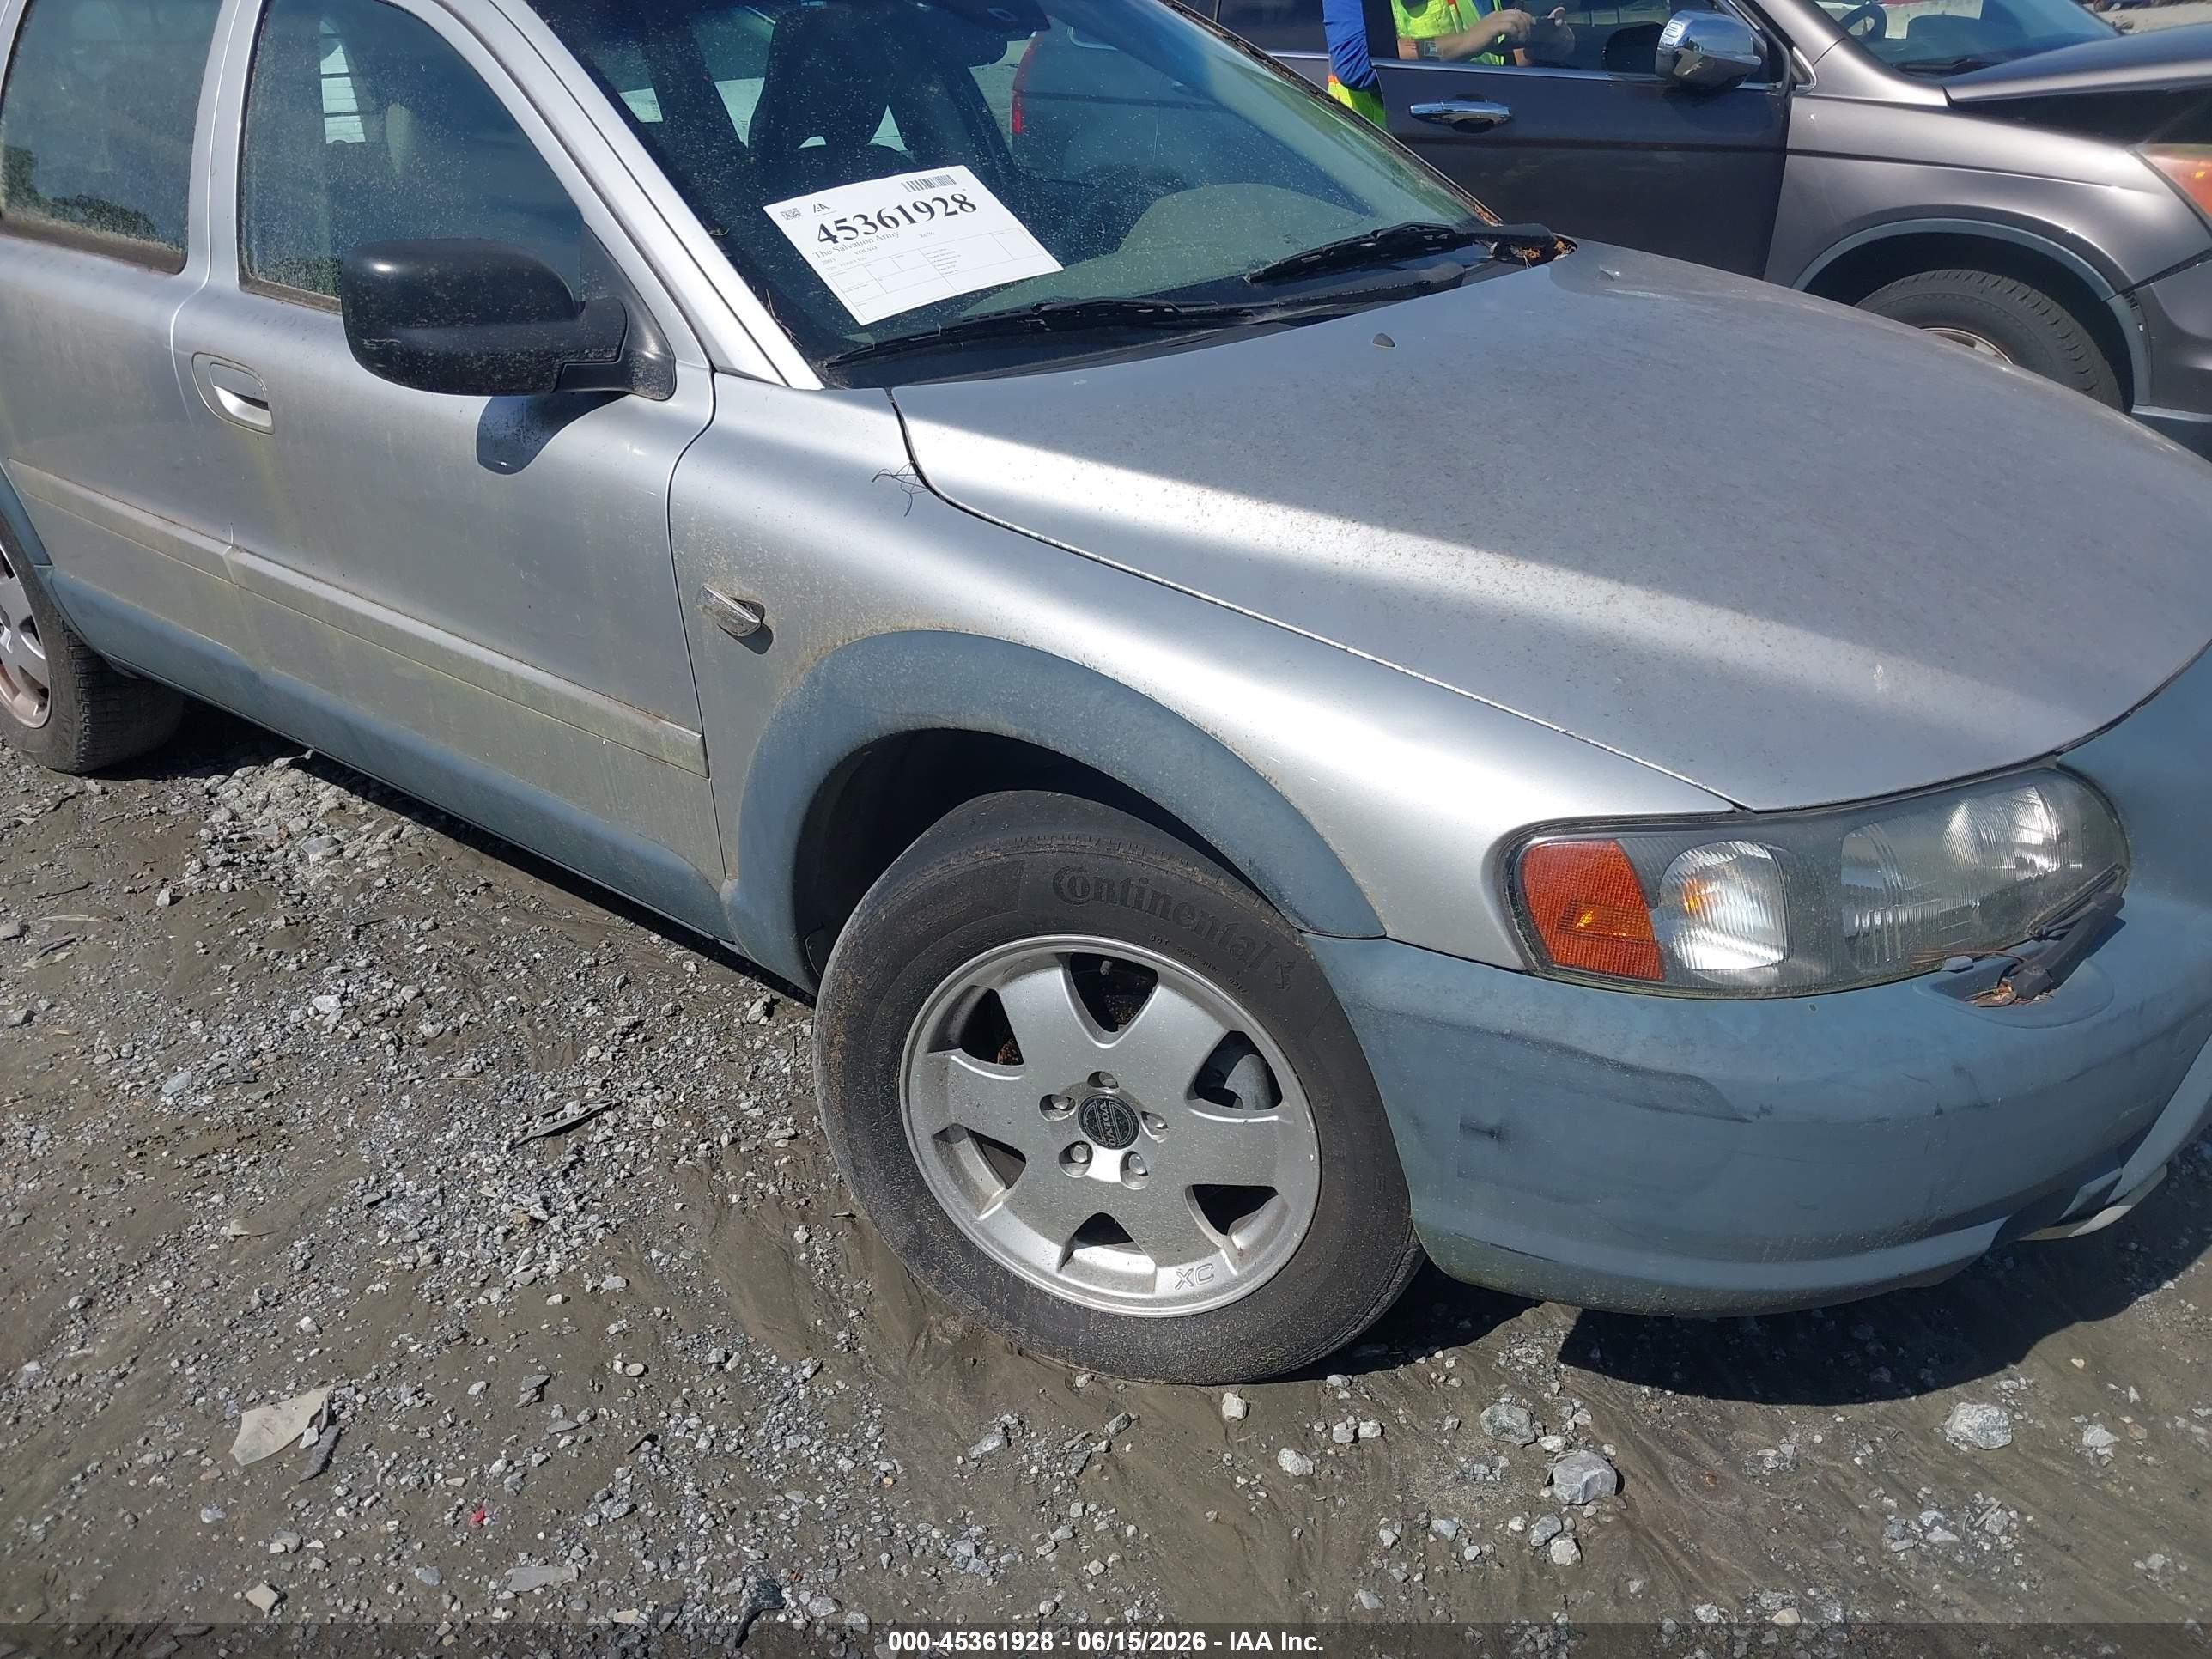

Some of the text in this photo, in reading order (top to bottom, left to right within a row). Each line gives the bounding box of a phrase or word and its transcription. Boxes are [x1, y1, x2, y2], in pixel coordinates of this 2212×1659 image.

[817, 192, 977, 245] 45361928
[812, 231, 899, 259] The Salvation Army
[1052, 865, 1278, 970] Continental
[1100, 1100, 1116, 1146] VOLVO
[1175, 1263, 1214, 1290] XC
